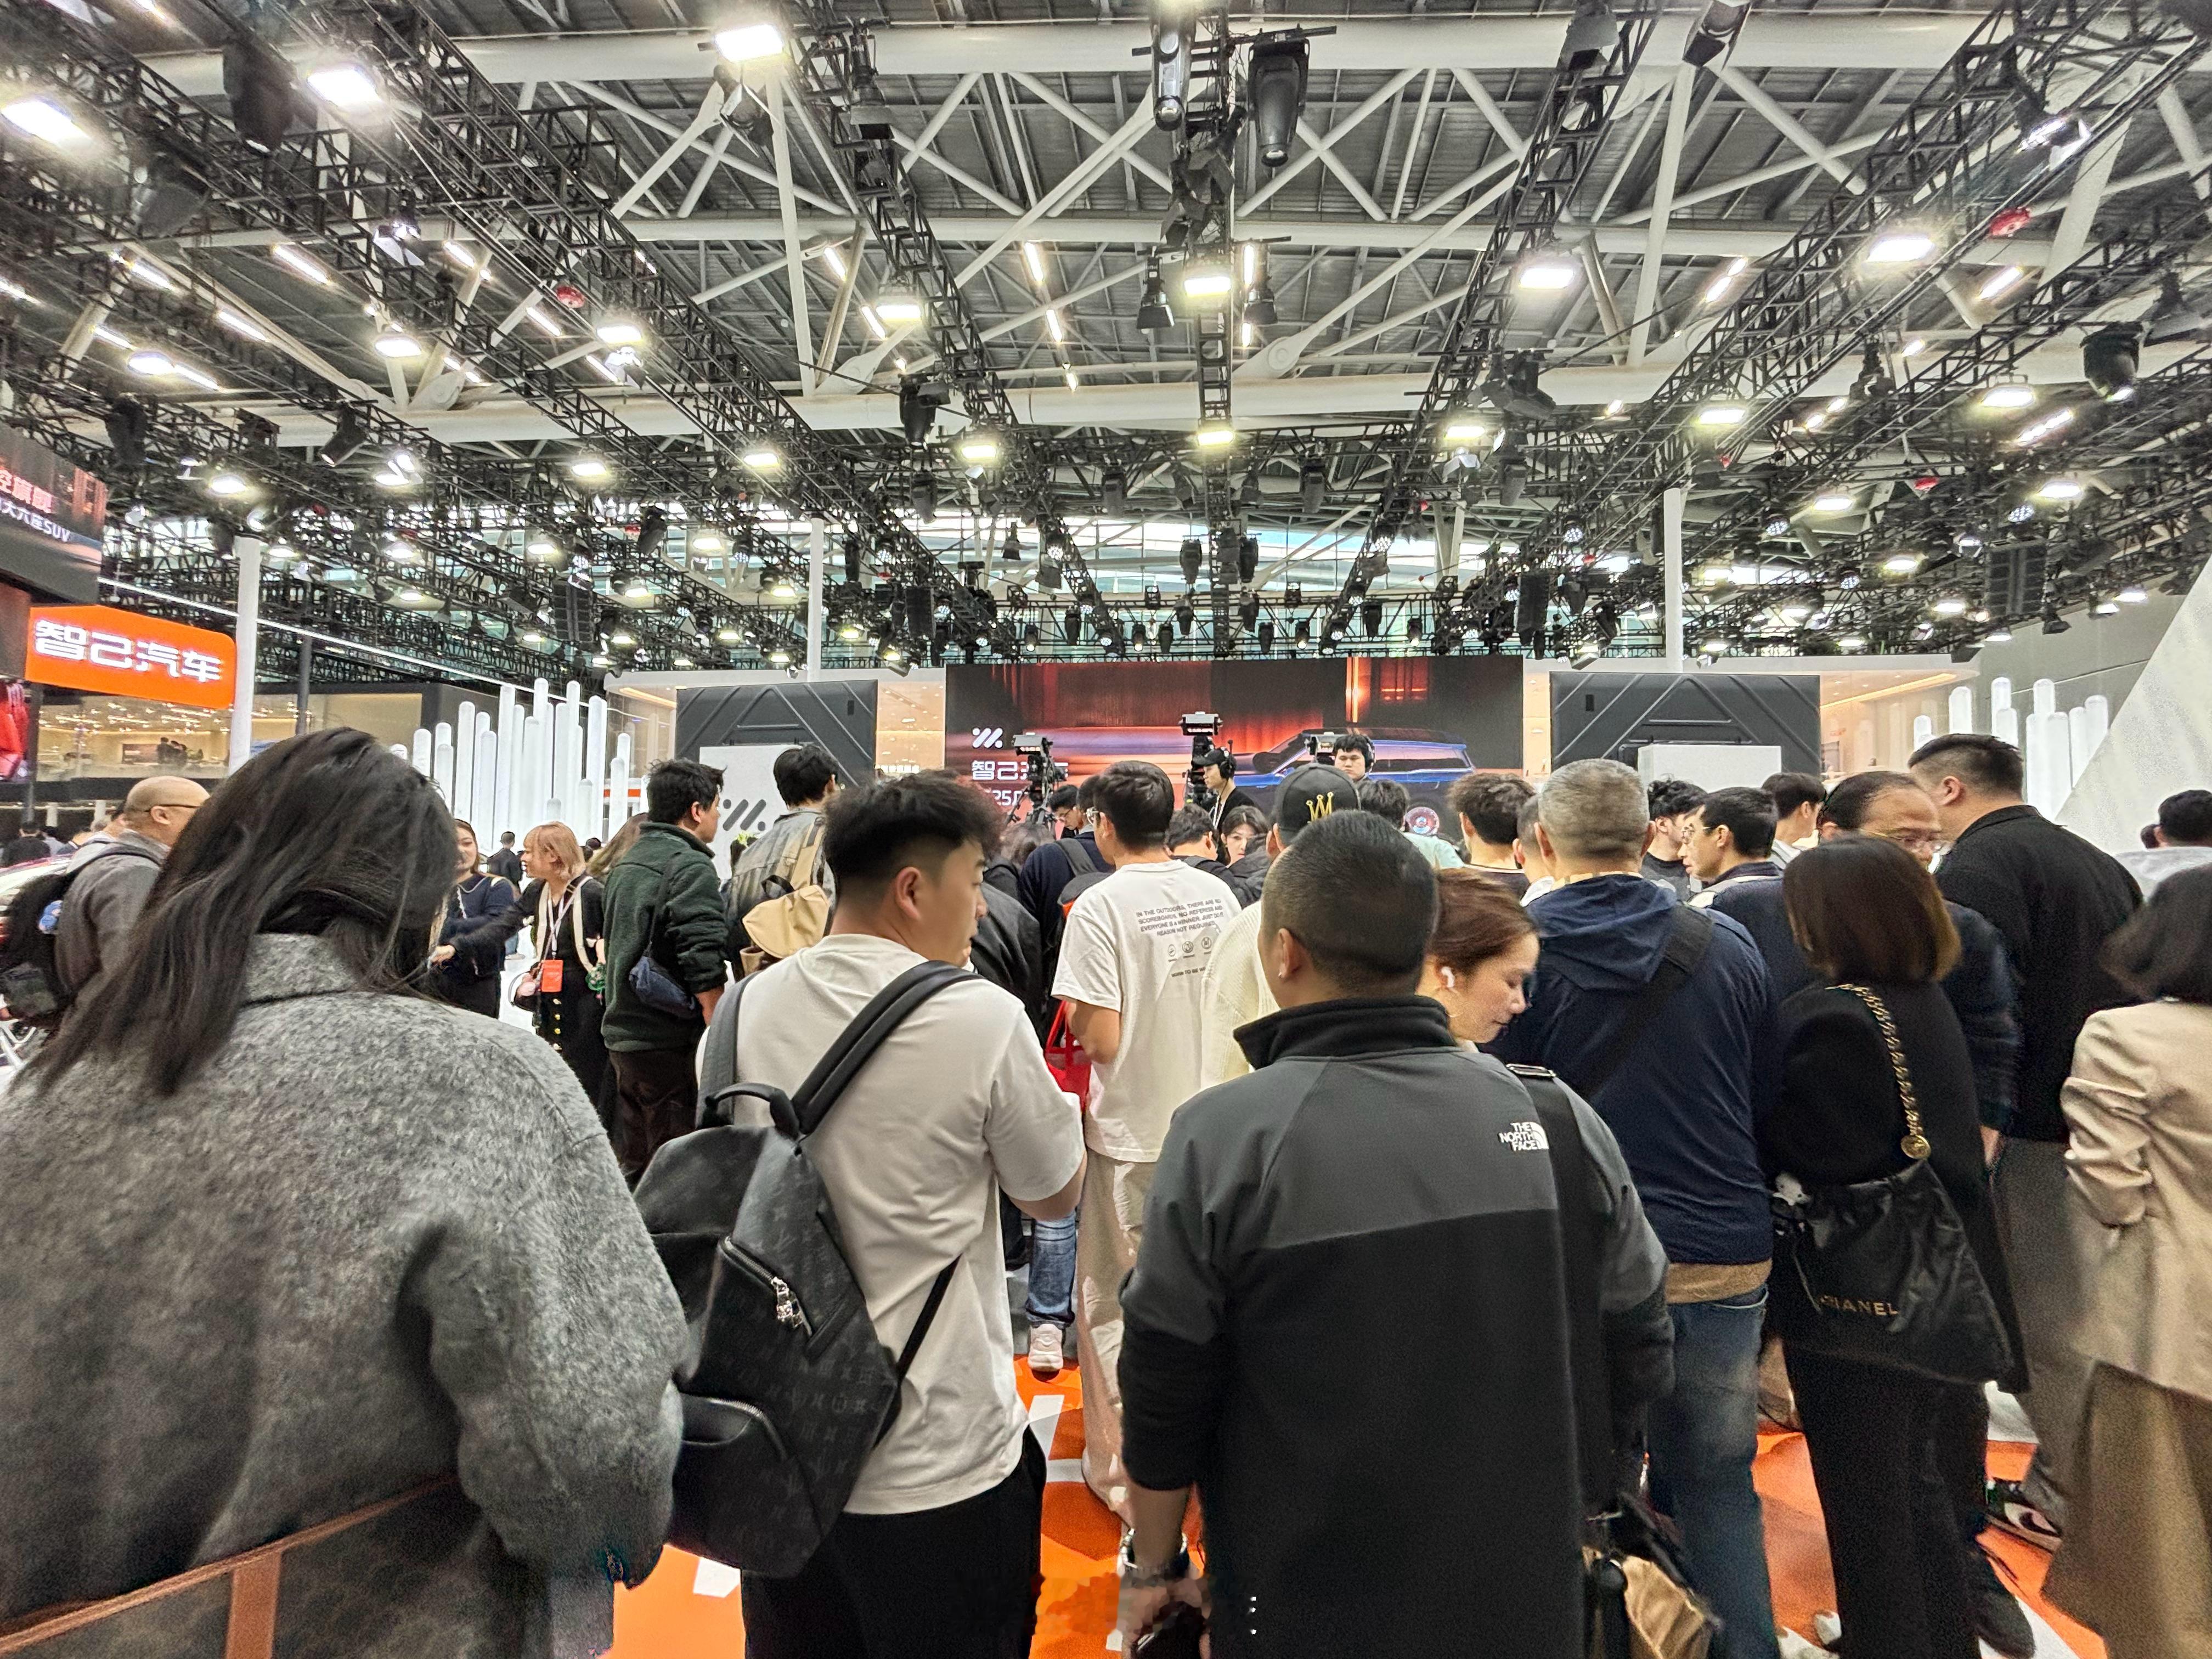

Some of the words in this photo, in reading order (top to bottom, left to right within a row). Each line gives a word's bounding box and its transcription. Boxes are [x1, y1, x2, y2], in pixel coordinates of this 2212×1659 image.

[0, 498, 71, 542] 大六座SUV
[35, 619, 222, 682] 智己汽车
[1140, 922, 1169, 932] EVERYONE
[1156, 928, 1176, 936] REASON
[1510, 1122, 1532, 1131] THE
[1498, 1131, 1534, 1143] NORTH
[1512, 1141, 1538, 1151] FACE
